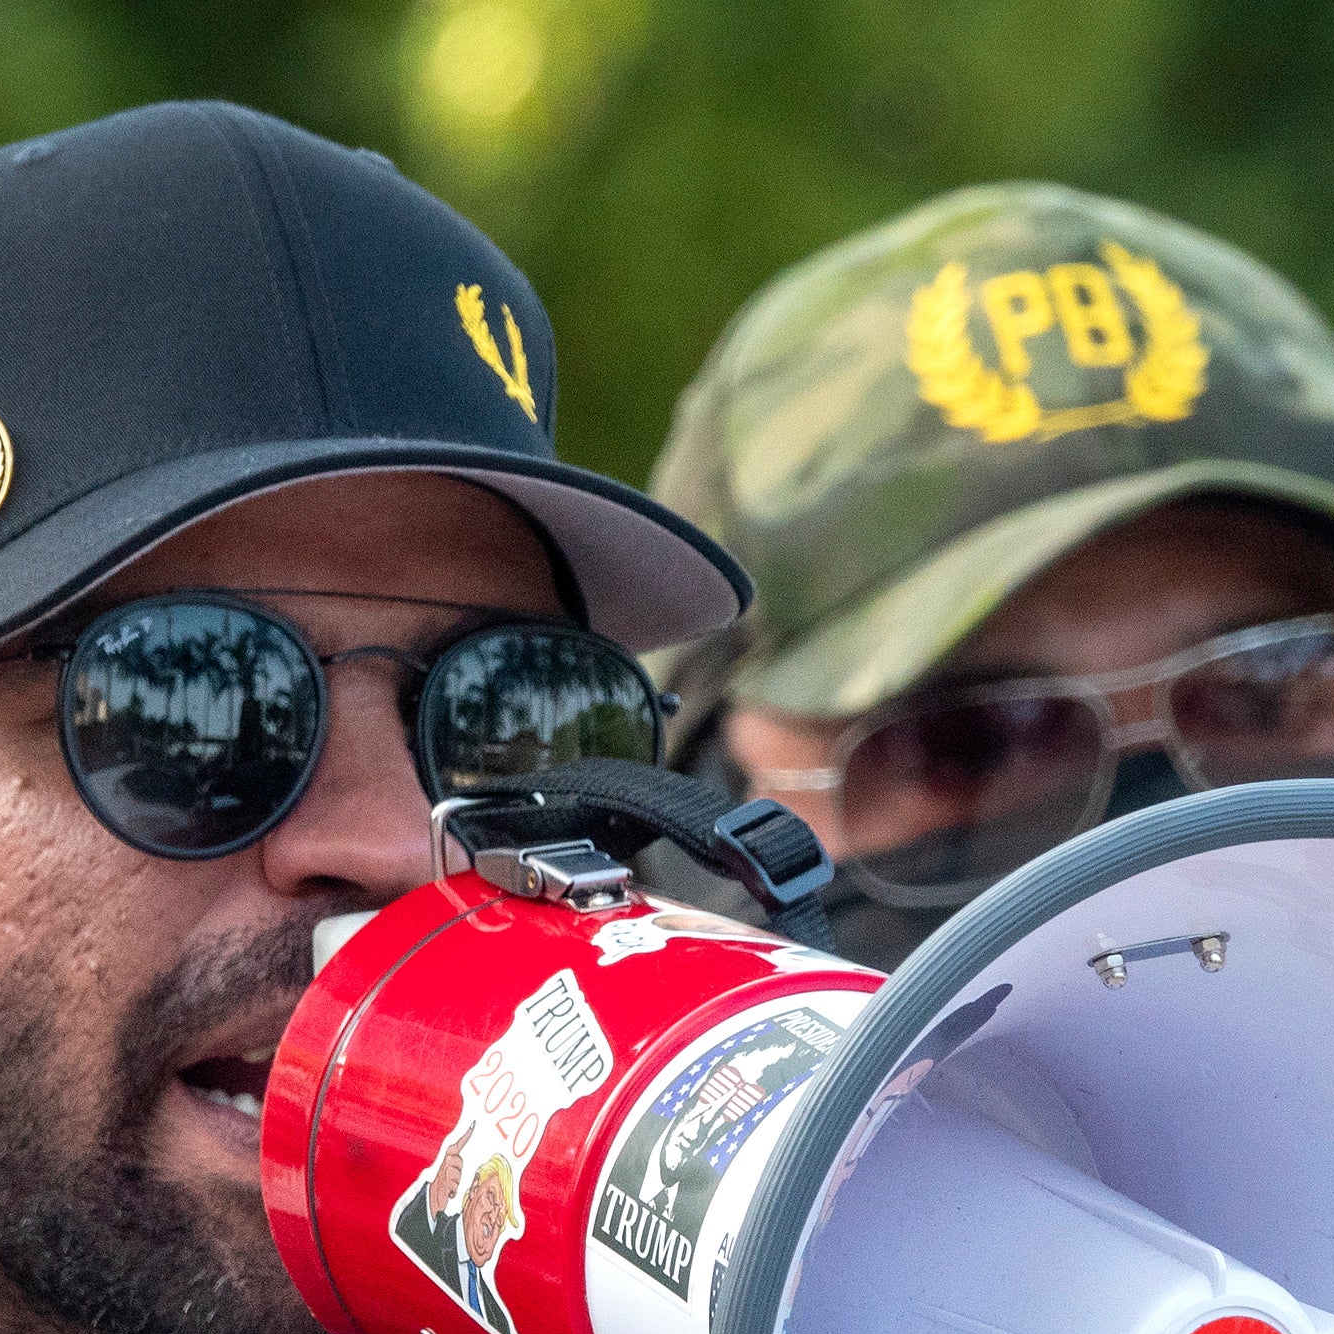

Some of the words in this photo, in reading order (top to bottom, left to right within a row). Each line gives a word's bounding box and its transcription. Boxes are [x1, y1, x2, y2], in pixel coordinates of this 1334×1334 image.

[981, 260, 1134, 378] PB
[525, 977, 605, 1093] TRUMP
[469, 1050, 539, 1159] 2020
[600, 1183, 693, 1284] TRUMP
